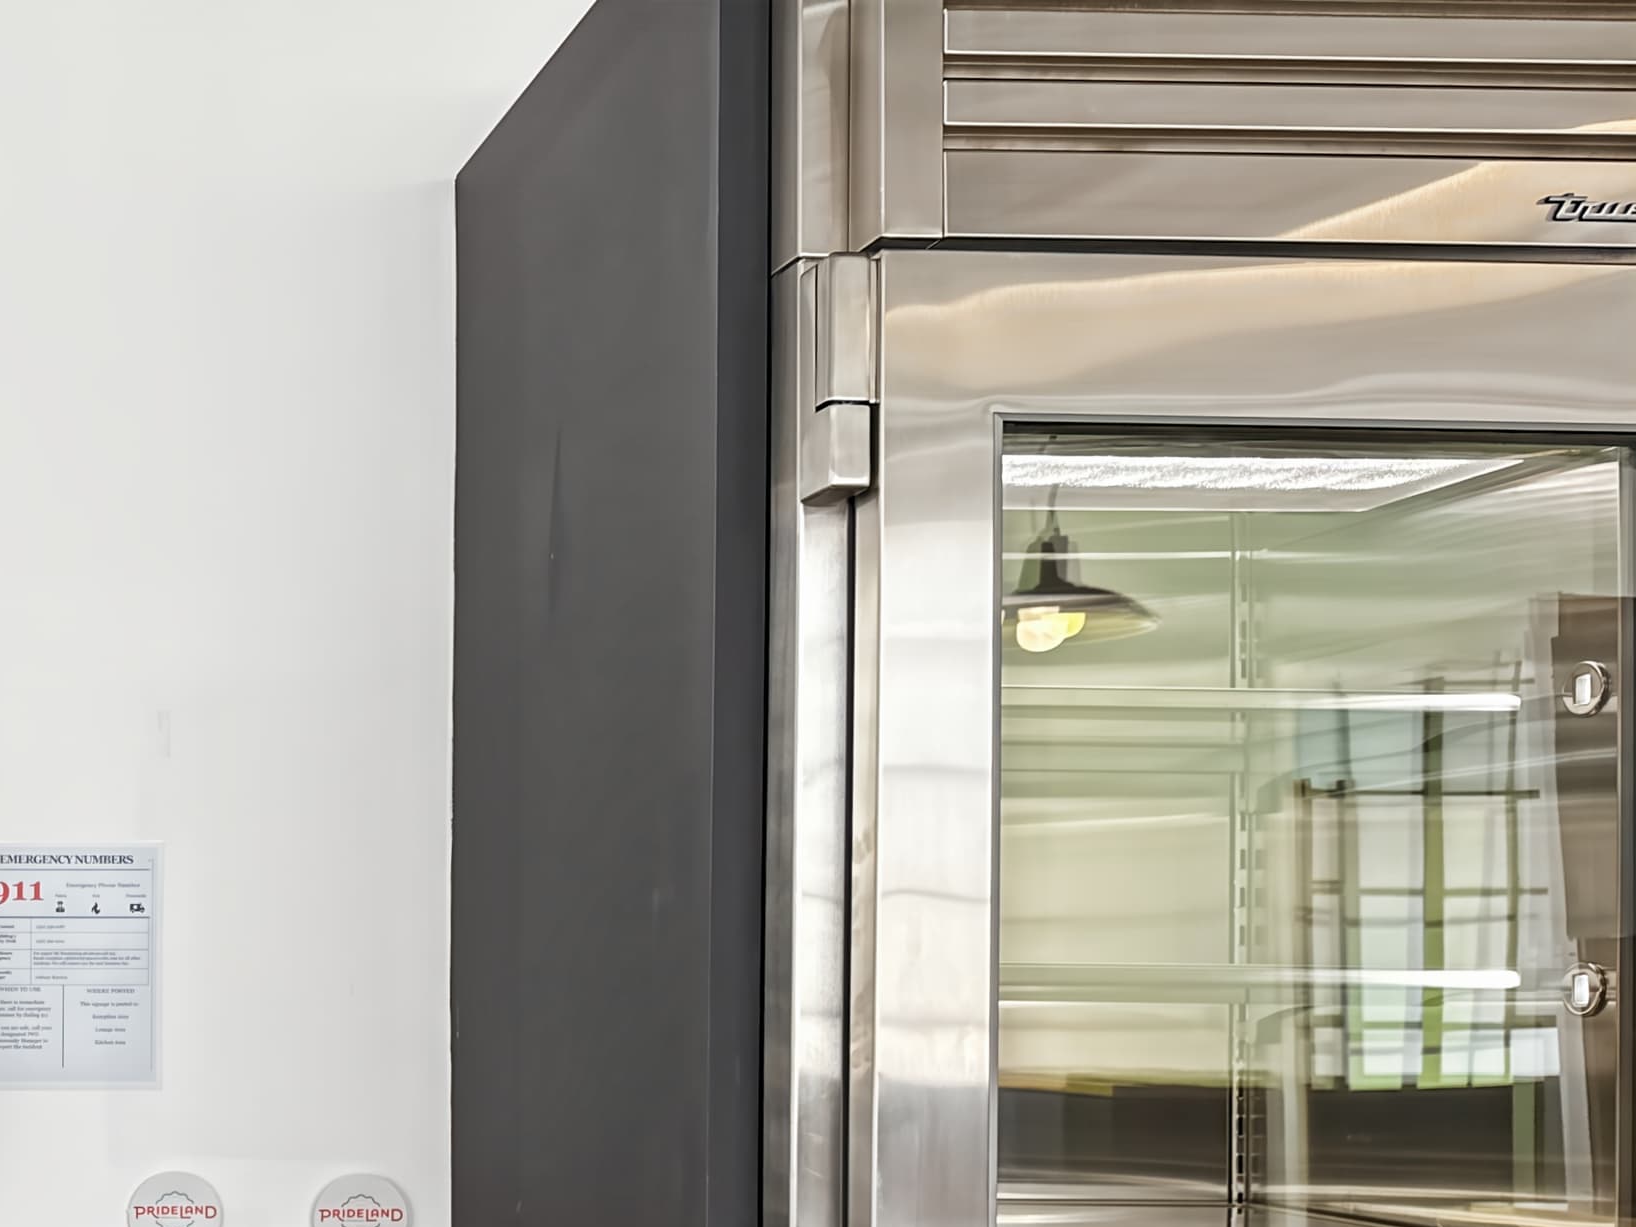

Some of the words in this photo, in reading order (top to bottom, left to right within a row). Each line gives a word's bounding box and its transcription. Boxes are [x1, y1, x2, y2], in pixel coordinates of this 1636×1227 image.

[0, 854, 73, 865] EMERGENCY
[74, 854, 134, 865] NUMBERS
[133, 1203, 217, 1220] PRIDELAND
[318, 1207, 404, 1223] PRIDELAND
